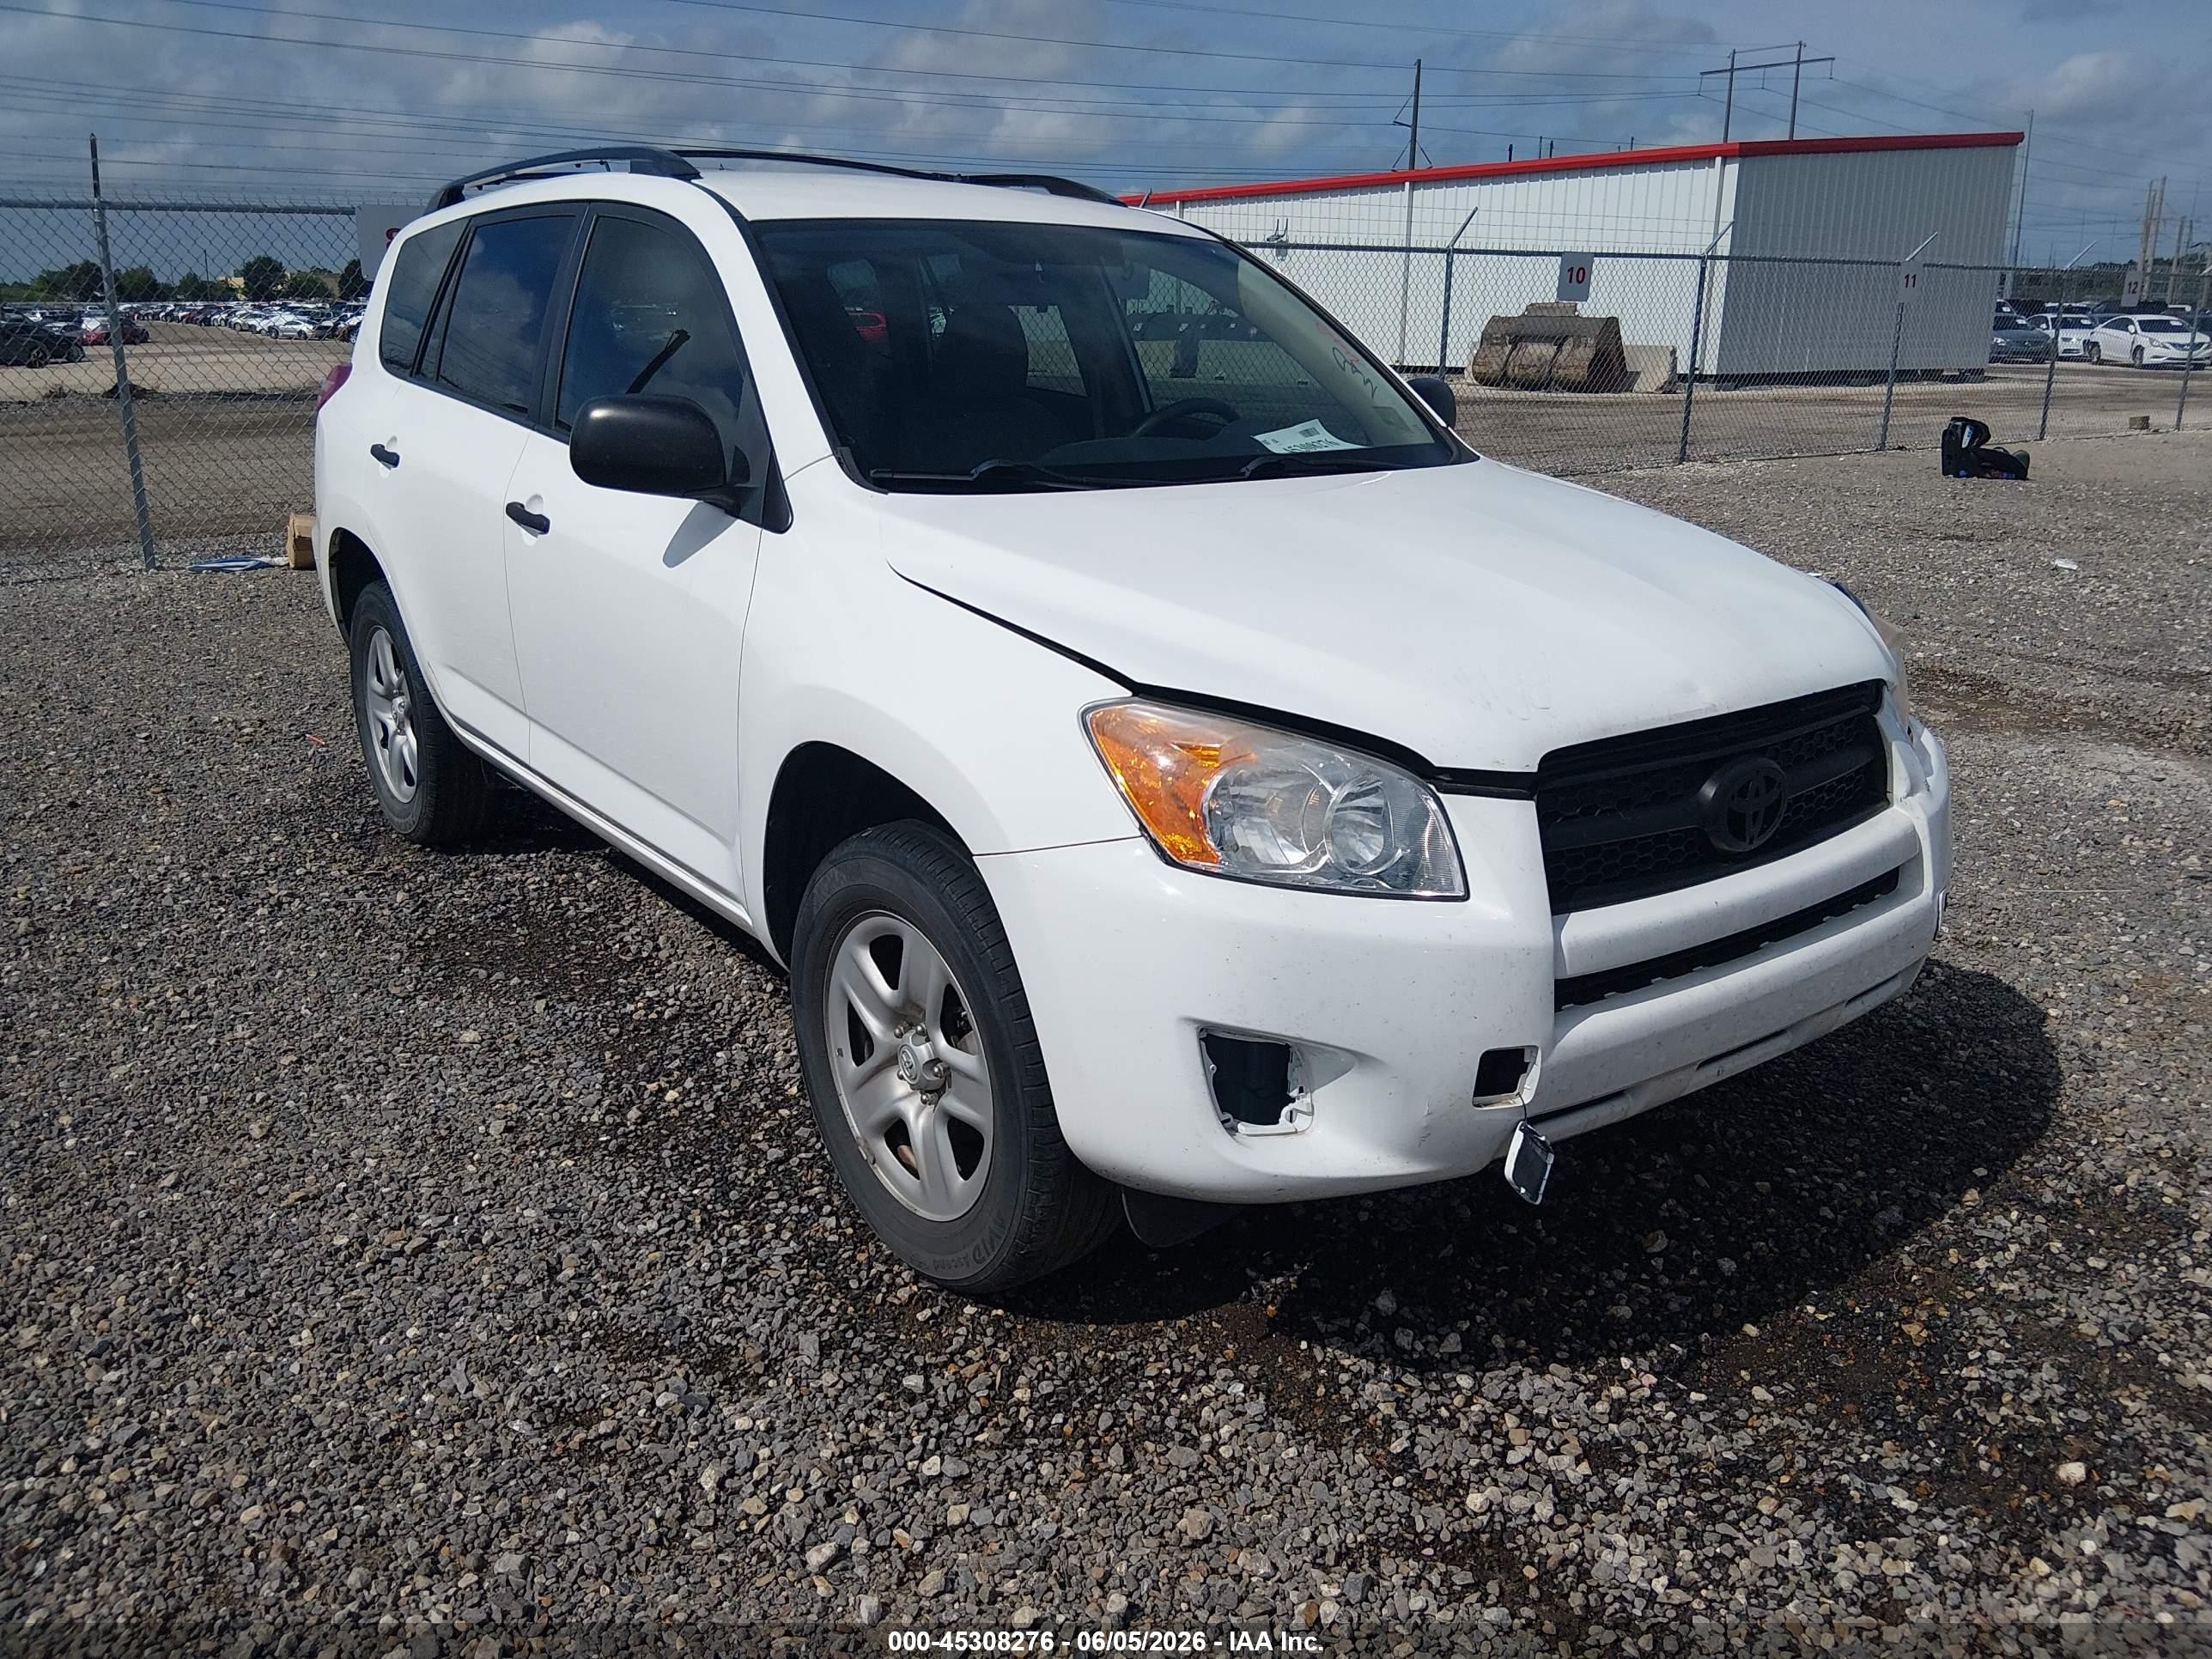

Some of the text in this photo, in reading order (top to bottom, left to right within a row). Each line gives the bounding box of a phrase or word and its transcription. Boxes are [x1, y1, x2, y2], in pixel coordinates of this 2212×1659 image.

[1567, 266, 1586, 284] 10
[1904, 273, 1917, 289] 11
[2127, 281, 2139, 295] 12
